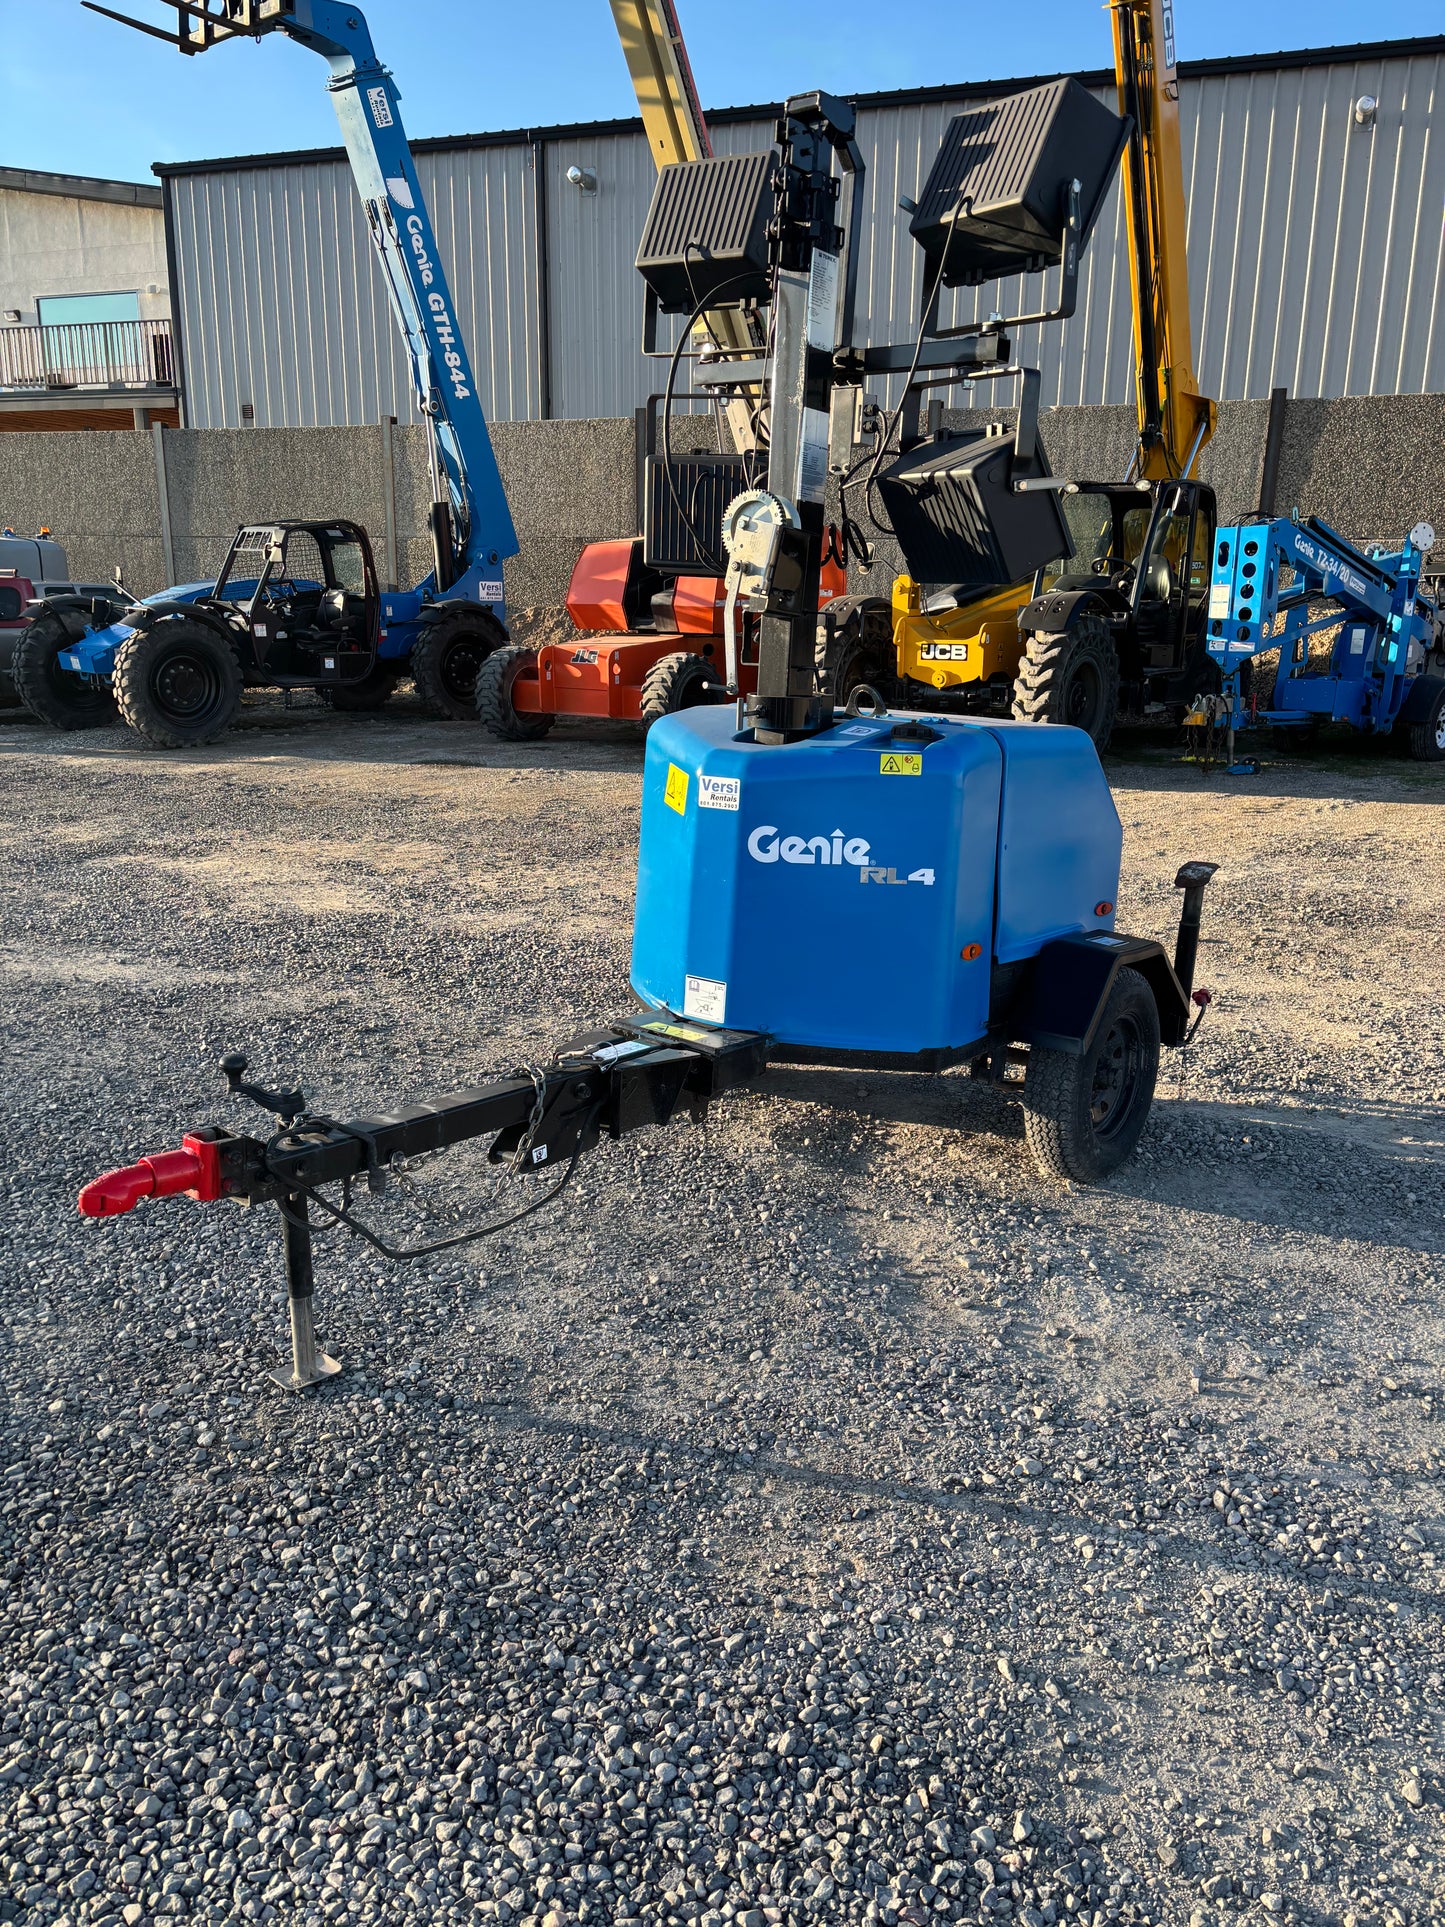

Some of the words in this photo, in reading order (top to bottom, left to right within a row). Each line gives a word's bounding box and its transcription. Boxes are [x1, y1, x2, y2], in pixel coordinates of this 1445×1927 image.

[1162, 0, 1174, 67] CB
[377, 89, 392, 124] Versi
[406, 215, 434, 288] Genie
[428, 292, 471, 399] GTH-844
[1294, 533, 1315, 559] Genie
[1316, 549, 1350, 584] TZ-34/20
[481, 582, 502, 592] Versi
[571, 649, 599, 664] JLG
[921, 644, 967, 660] JCB
[702, 777, 738, 794] Versi
[710, 793, 737, 803] Rentals
[747, 825, 871, 866] Genie
[860, 866, 936, 886] RL4
